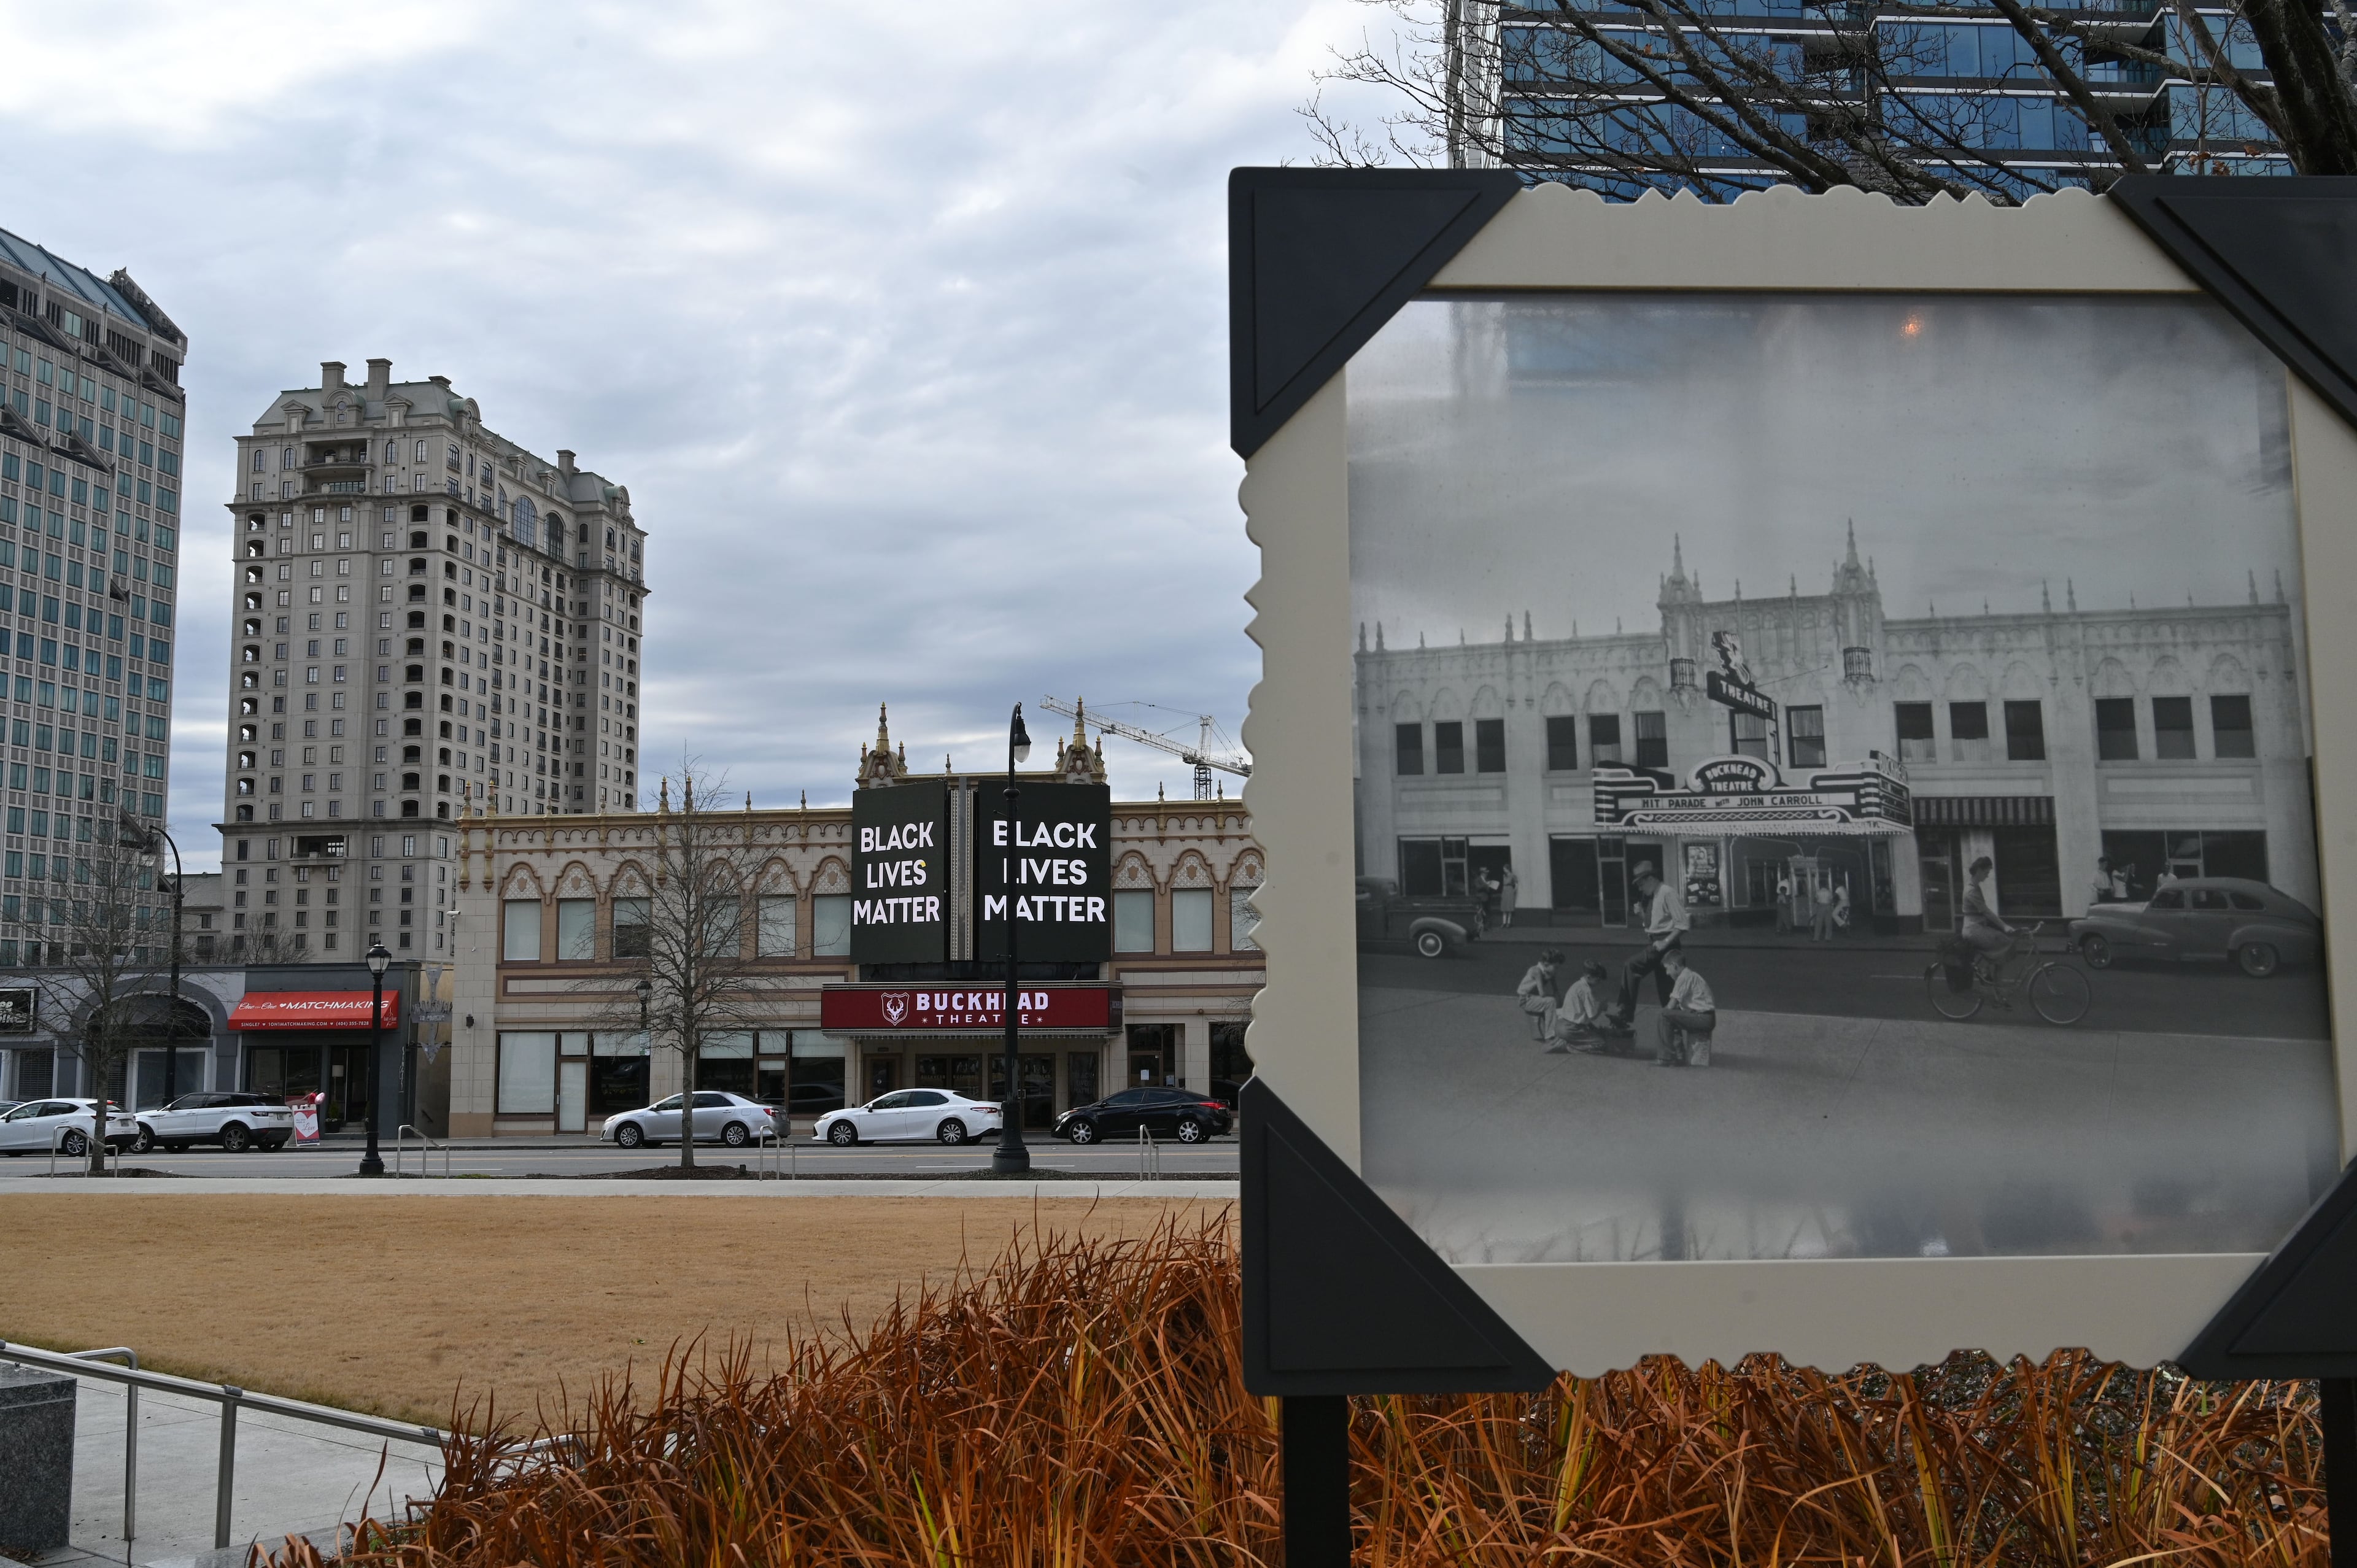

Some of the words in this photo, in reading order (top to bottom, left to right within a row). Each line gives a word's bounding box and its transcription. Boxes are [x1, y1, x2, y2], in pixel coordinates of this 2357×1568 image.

[1720, 680, 1770, 713] THEATRE
[1705, 763, 1757, 780] BUCKHEAD
[1710, 780, 1754, 792] THEATRE
[1643, 799, 1660, 808] HIT
[1668, 798, 1706, 808] PARADE
[1737, 797, 1764, 806] JOHN
[1771, 795, 1822, 805] CARROLL
[861, 821, 934, 853] BLACK
[993, 820, 1097, 849] BLACK
[867, 859, 927, 889] LIVES
[853, 896, 940, 925] MATTER
[984, 895, 1106, 922] MATTER
[238, 1002, 255, 1010] One
[261, 1002, 277, 1010] One
[916, 992, 1048, 1011] BUCKHAD
[935, 1014, 1029, 1025] THEATE
